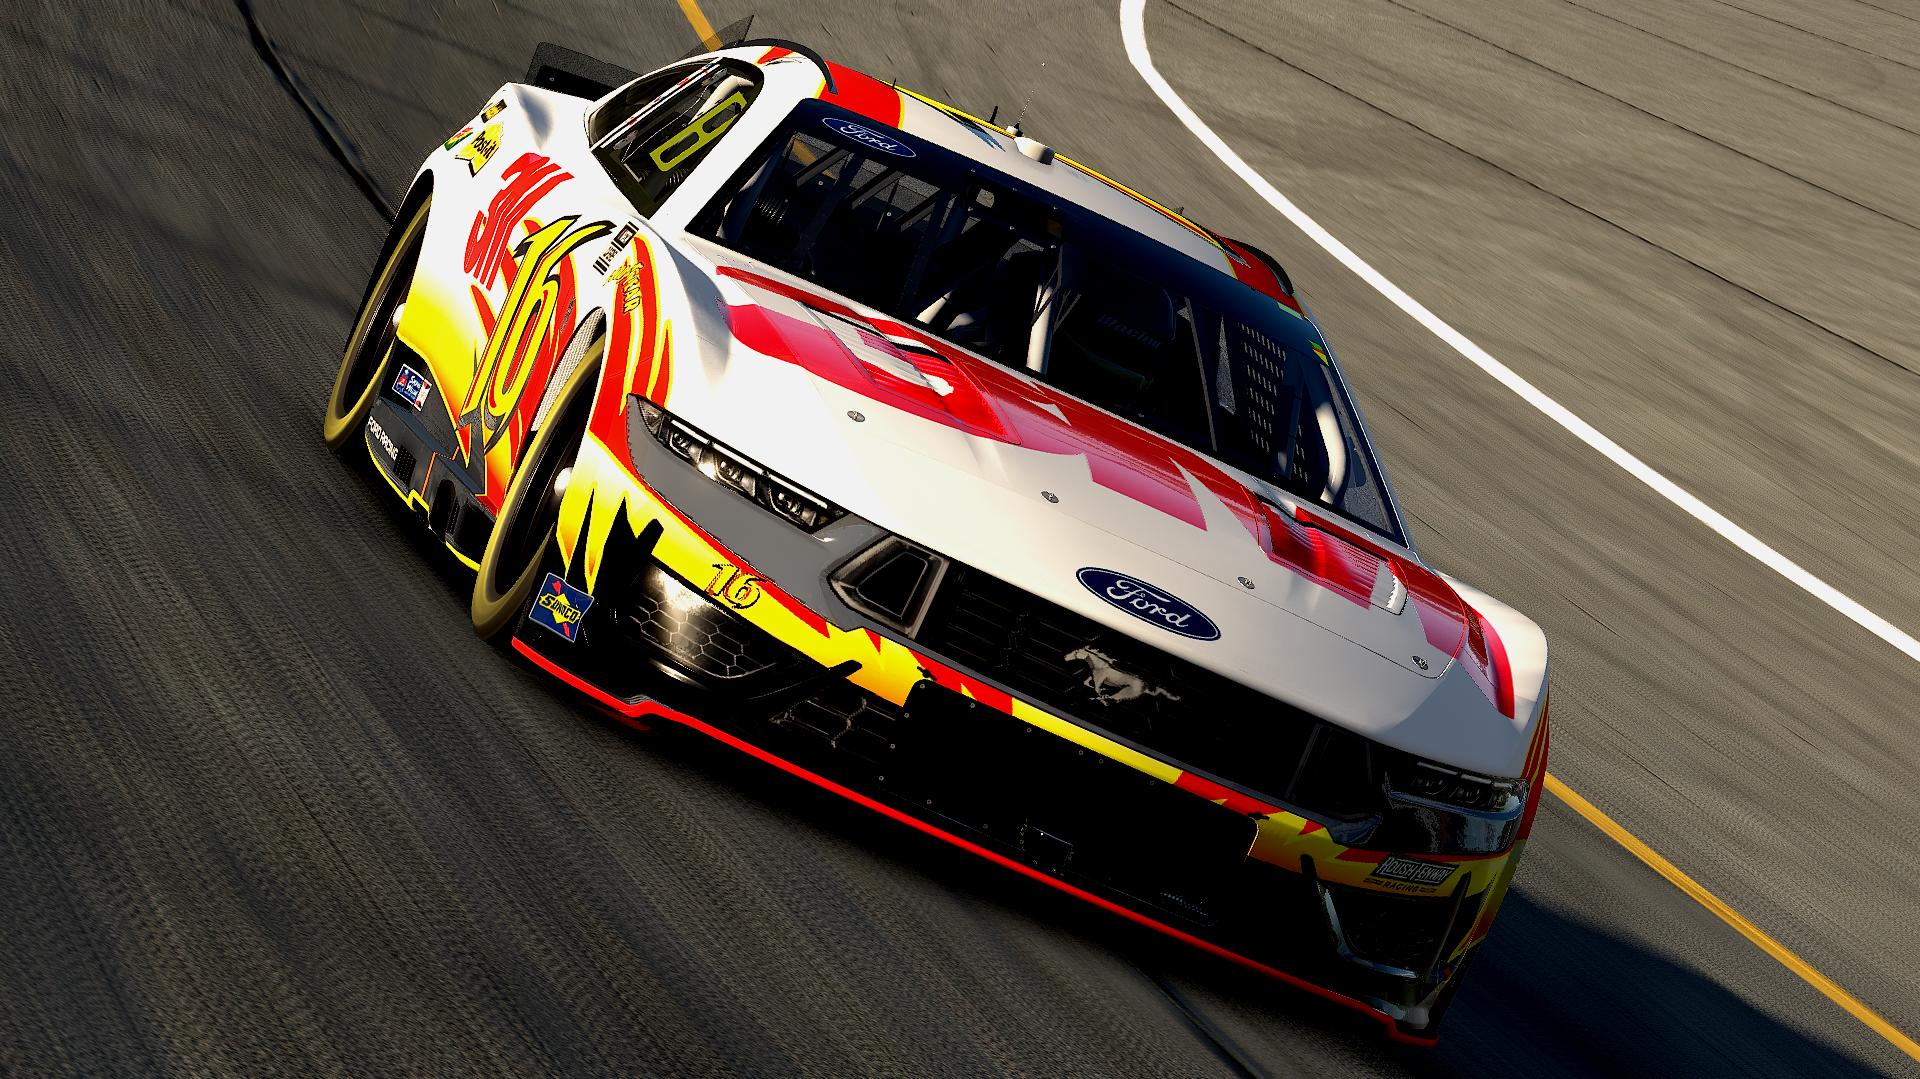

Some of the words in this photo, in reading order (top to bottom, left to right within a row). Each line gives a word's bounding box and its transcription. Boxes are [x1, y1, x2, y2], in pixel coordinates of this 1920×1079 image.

[840, 124, 898, 151] Ford
[458, 214, 618, 436] 16
[703, 563, 768, 610] 16
[1106, 579, 1193, 628] Ford
[1376, 856, 1418, 878] ROUSH
[1410, 863, 1454, 883] FENWAY
[1383, 880, 1419, 893] RACING
